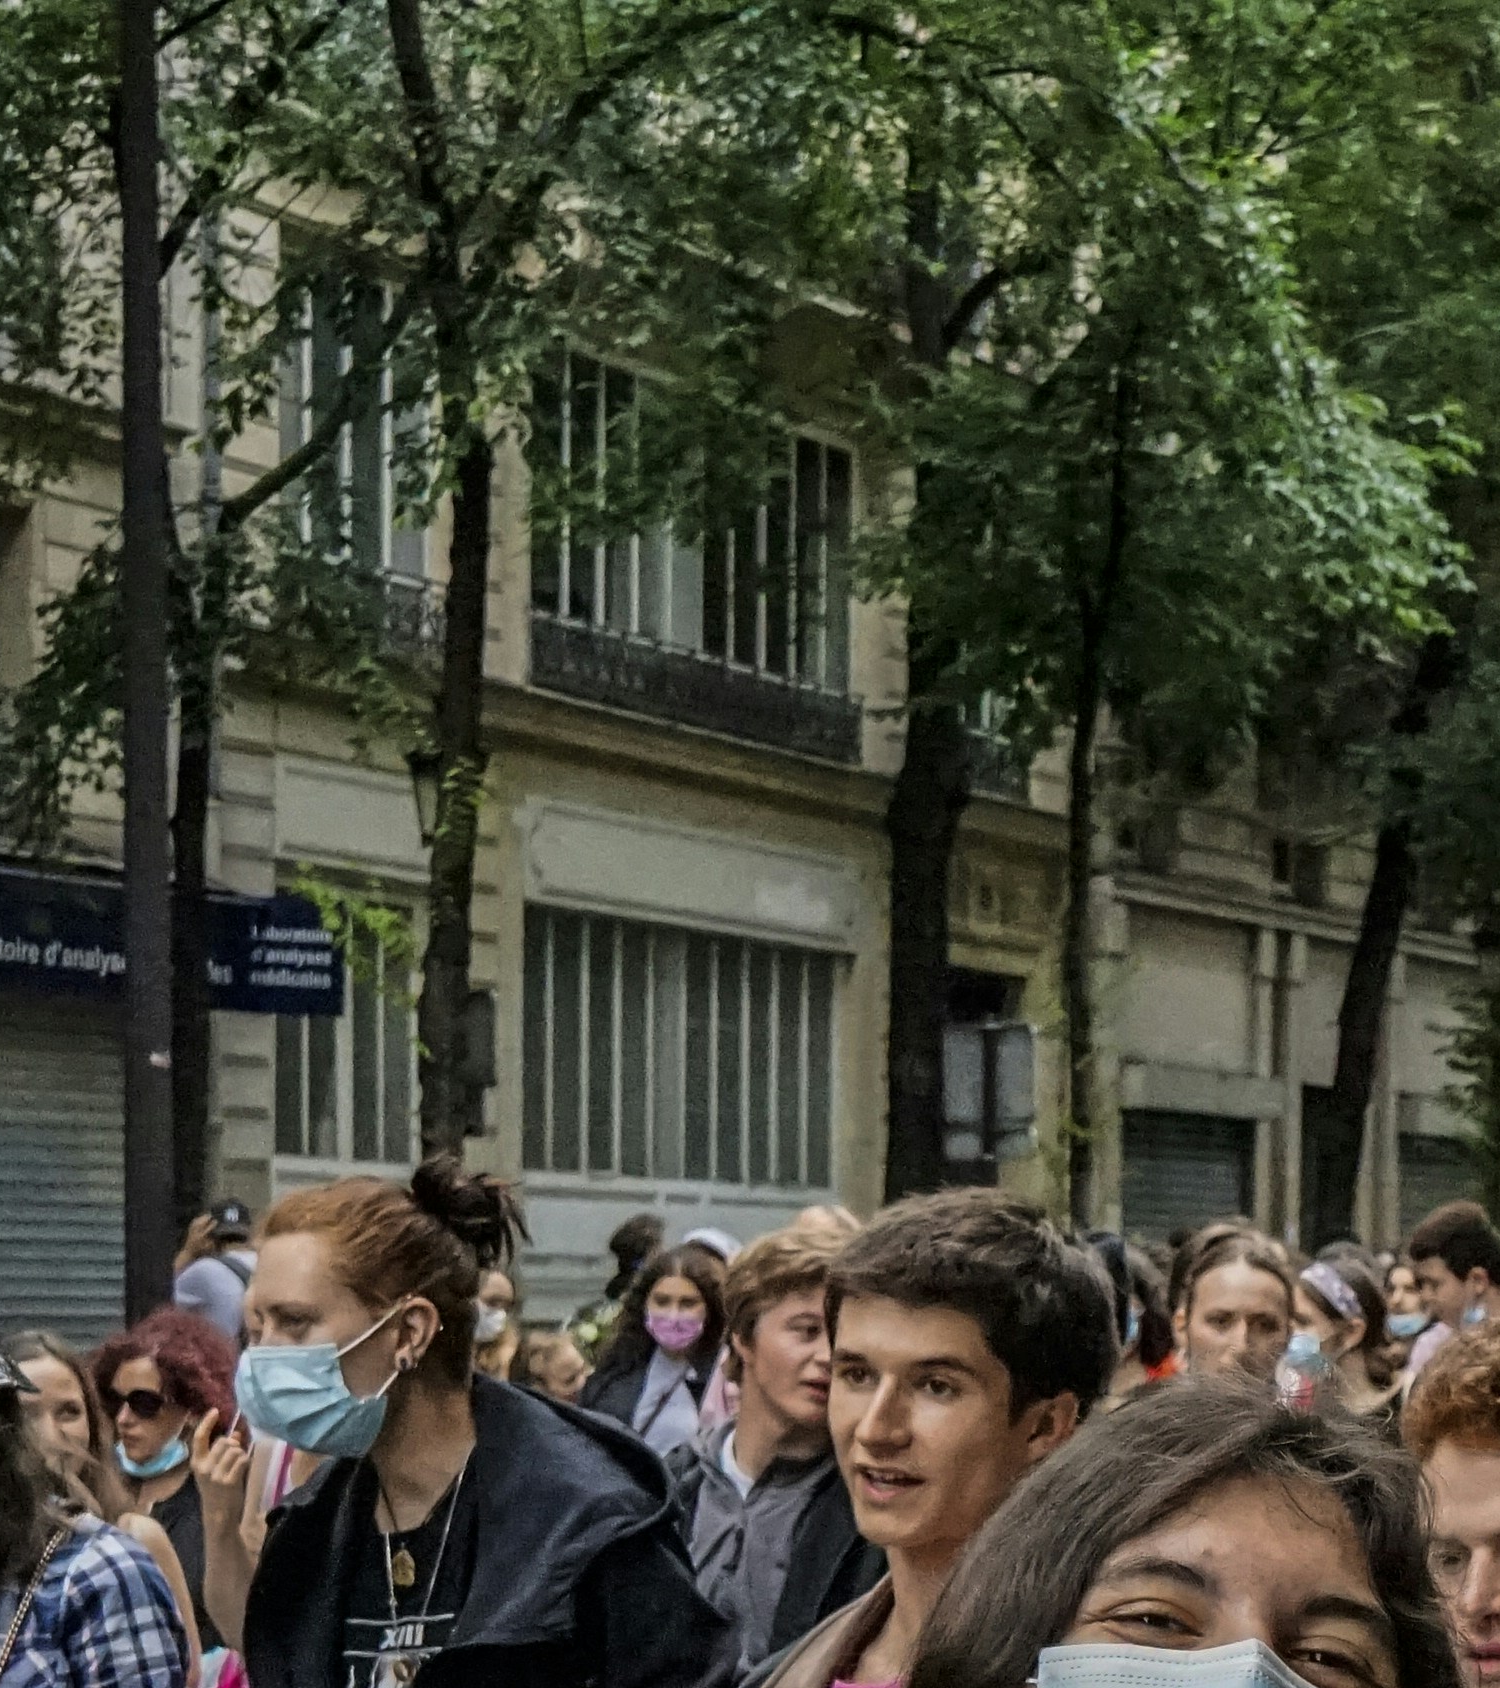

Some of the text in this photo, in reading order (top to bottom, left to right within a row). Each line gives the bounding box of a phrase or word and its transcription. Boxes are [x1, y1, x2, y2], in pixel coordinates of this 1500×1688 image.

[251, 924, 334, 943] Laboratoire
[44, 940, 127, 978] d'analyse
[251, 946, 333, 968] d'analyses
[380, 1624, 425, 1650] XIII
